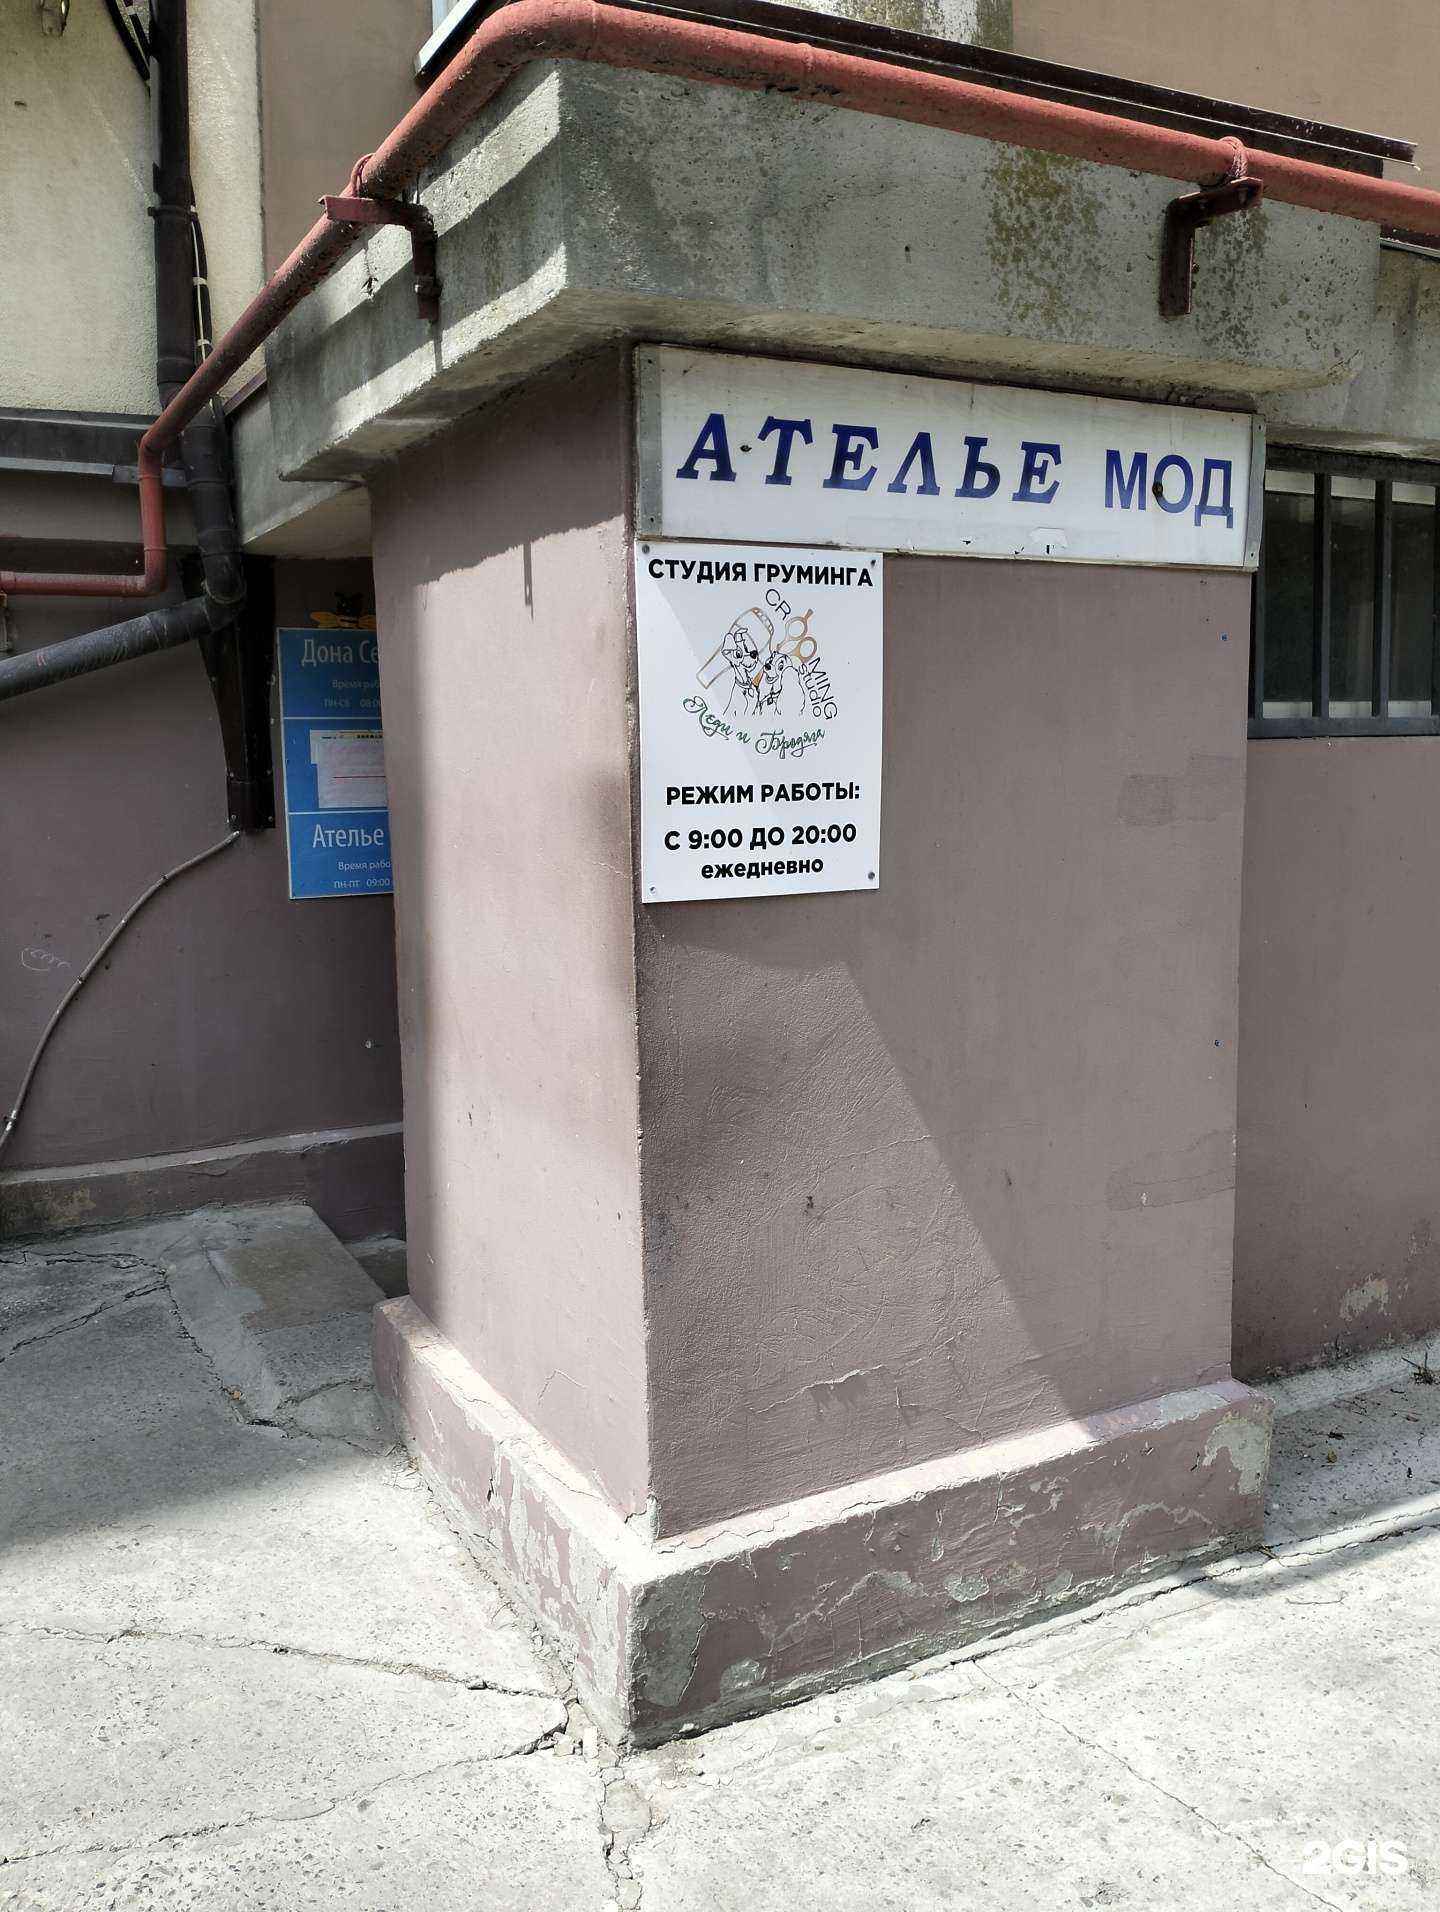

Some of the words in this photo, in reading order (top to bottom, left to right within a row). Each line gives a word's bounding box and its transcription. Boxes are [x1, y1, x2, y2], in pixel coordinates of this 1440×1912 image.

[676, 412, 1063, 504] АТЕЛЬЕ
[1105, 448, 1234, 528] МОД
[648, 558, 747, 585] СТУДИЯ
[754, 563, 874, 587] ГРУМИНГА
[301, 639, 353, 667] Дона
[798, 663, 822, 718] studio
[735, 731, 751, 744] и
[755, 728, 826, 760] Бродяга
[666, 784, 754, 806] РЕЖИМ
[761, 781, 861, 803] РАБОТЫ:
[312, 823, 385, 848] Ателье
[664, 831, 681, 851] С
[688, 828, 743, 849] 9:00
[749, 826, 786, 851] ДО
[791, 823, 857, 845] 20:00
[338, 861, 368, 872] Время
[701, 858, 824, 879] ежедневно
